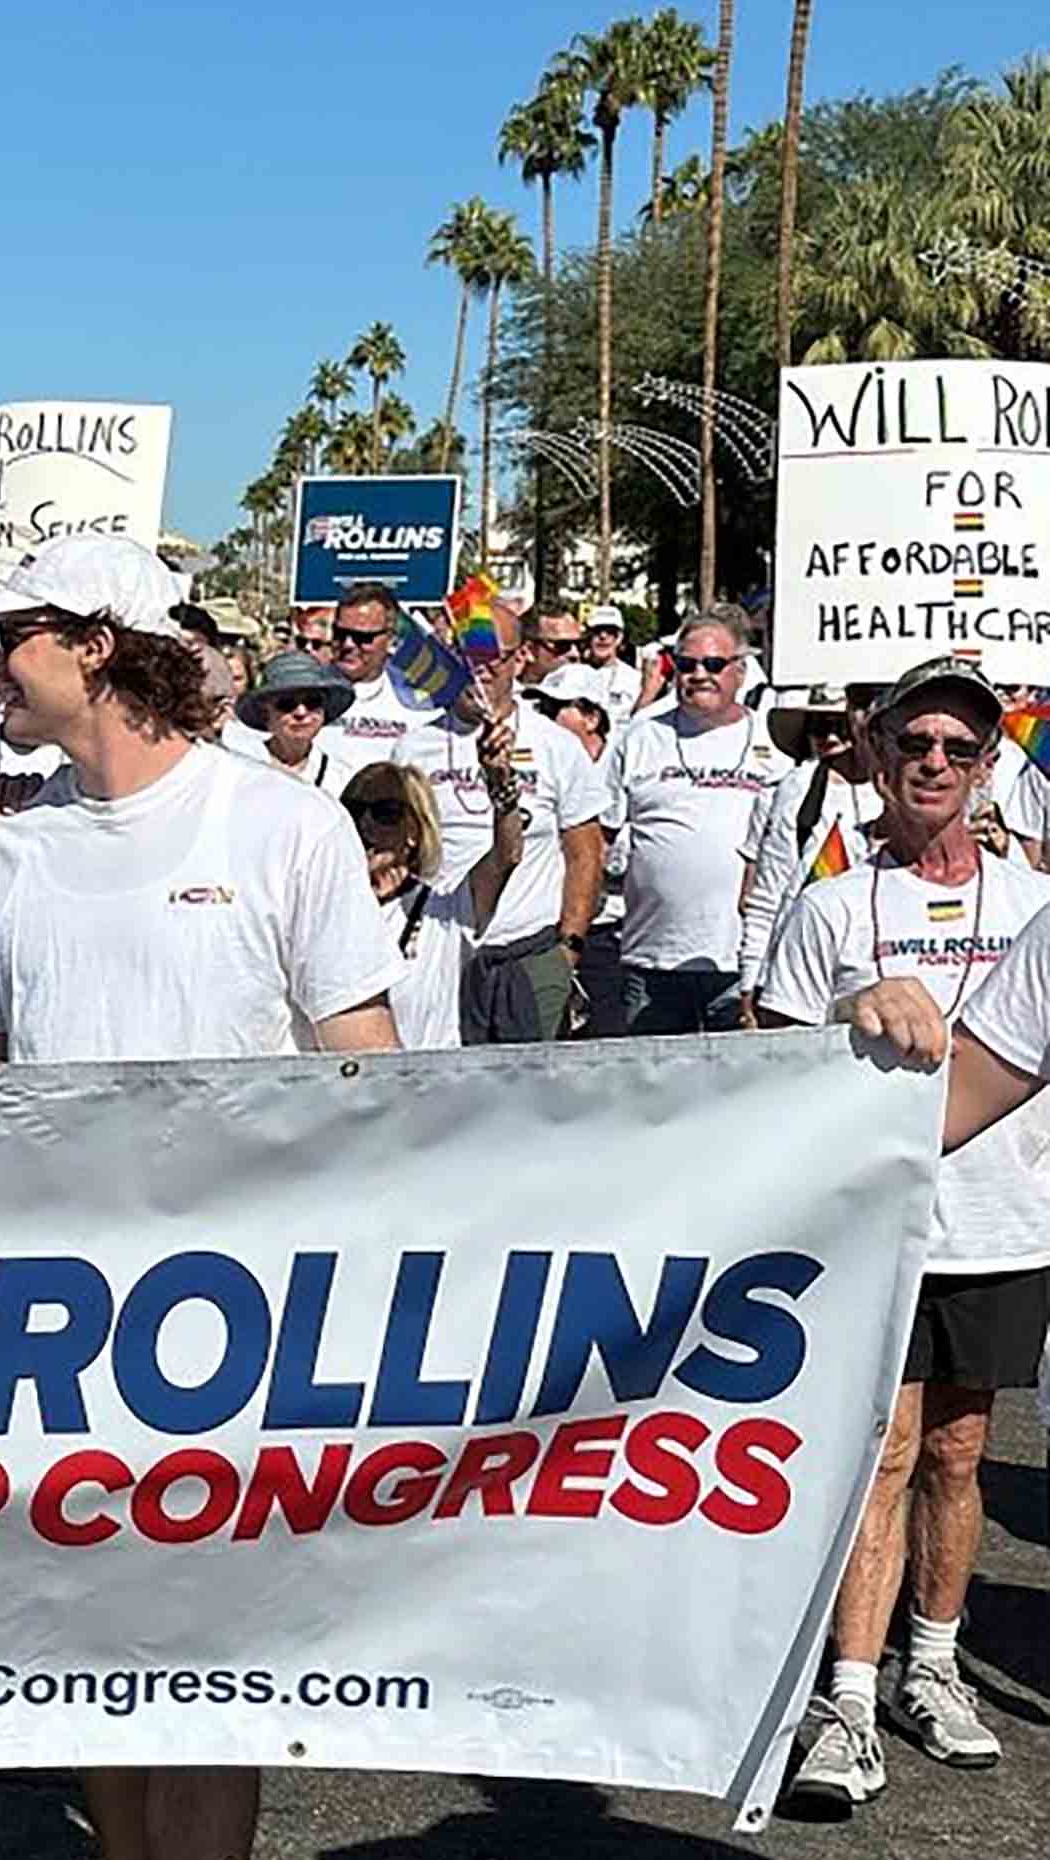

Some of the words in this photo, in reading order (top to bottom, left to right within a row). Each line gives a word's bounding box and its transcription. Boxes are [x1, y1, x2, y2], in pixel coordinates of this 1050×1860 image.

[993, 374, 1050, 447] RO
[926, 470, 1022, 509] FOR
[323, 526, 444, 550] ROLLINS
[806, 541, 1039, 579] AFFORDABLE
[891, 937, 938, 955] WILL
[29, 1411, 803, 1547] CONGRESS
